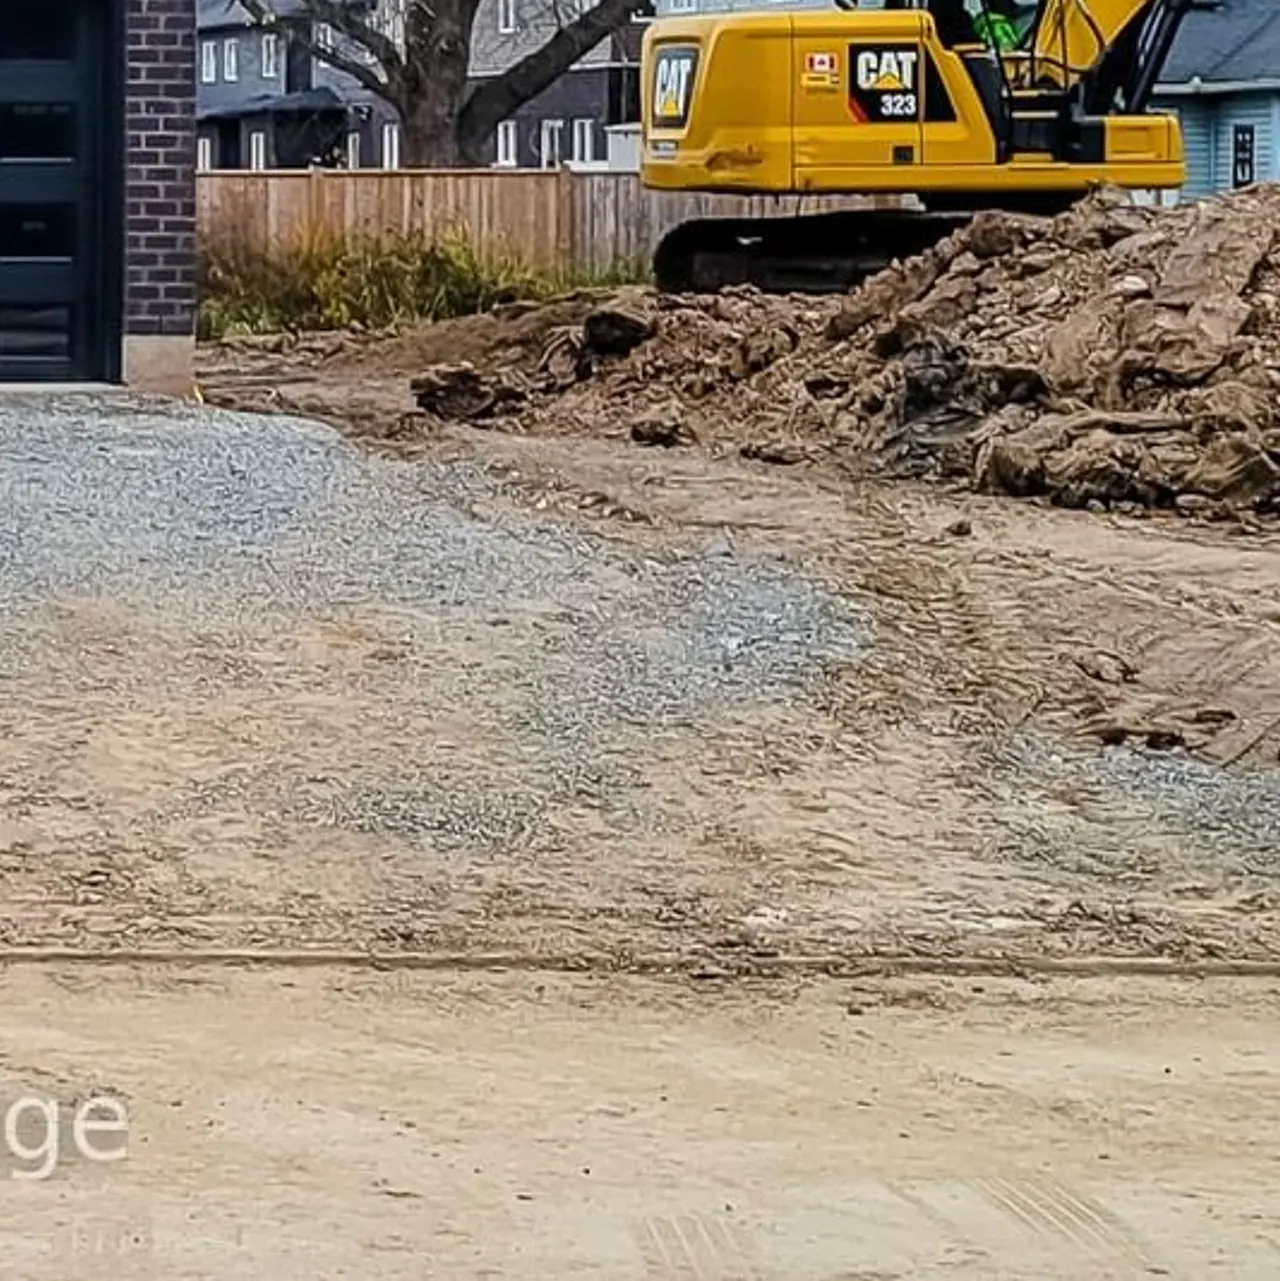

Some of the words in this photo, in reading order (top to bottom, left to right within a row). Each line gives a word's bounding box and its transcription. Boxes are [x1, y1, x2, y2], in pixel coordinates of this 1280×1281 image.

[654, 58, 691, 117] CAT
[857, 51, 917, 90] CAT
[880, 93, 916, 116] 323
